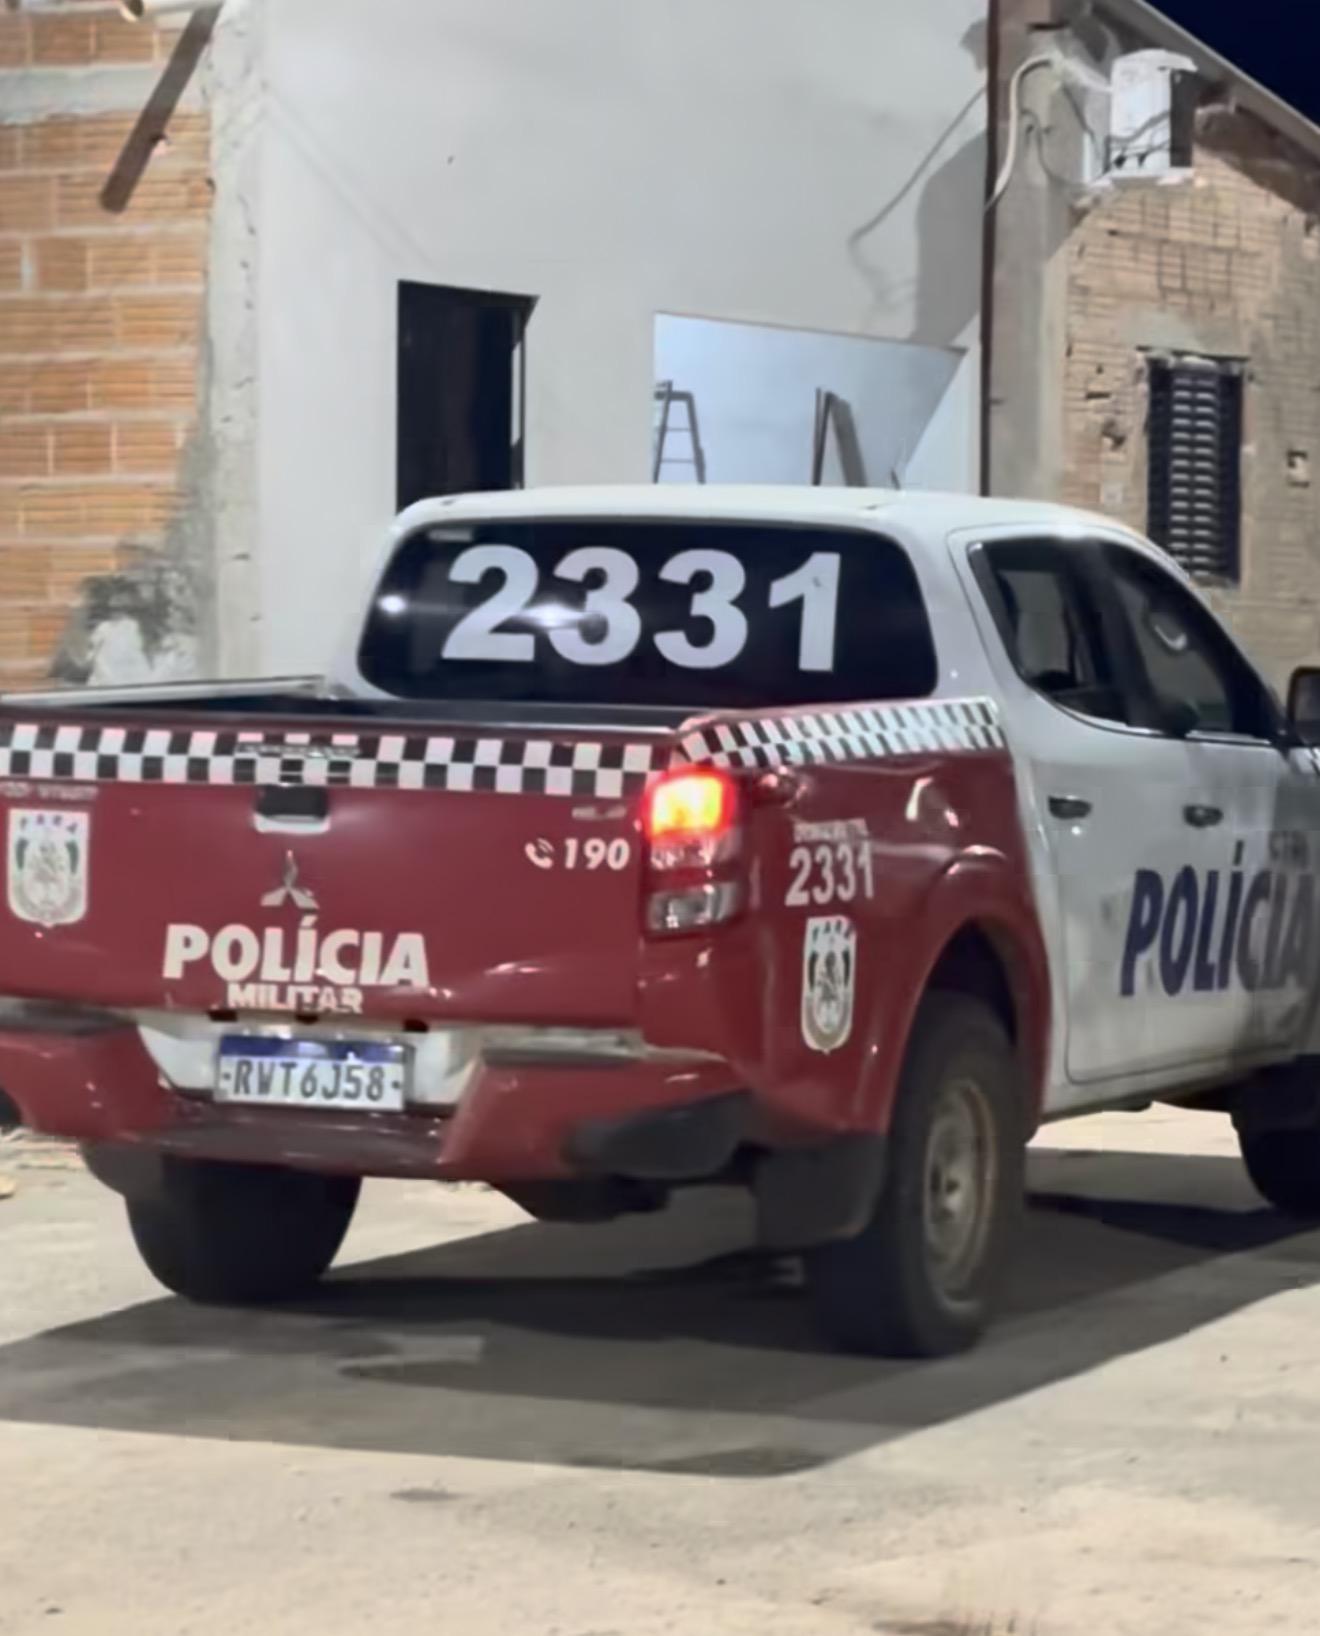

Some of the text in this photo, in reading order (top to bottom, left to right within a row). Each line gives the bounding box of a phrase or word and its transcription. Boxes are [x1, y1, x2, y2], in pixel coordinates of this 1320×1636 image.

[441, 544, 841, 673] 2331
[565, 838, 630, 870] 190
[785, 841, 874, 907] 2331
[162, 915, 430, 988] POLÍCIA
[227, 982, 363, 1014] MILITAR
[233, 1059, 385, 1101] RWT6J58
